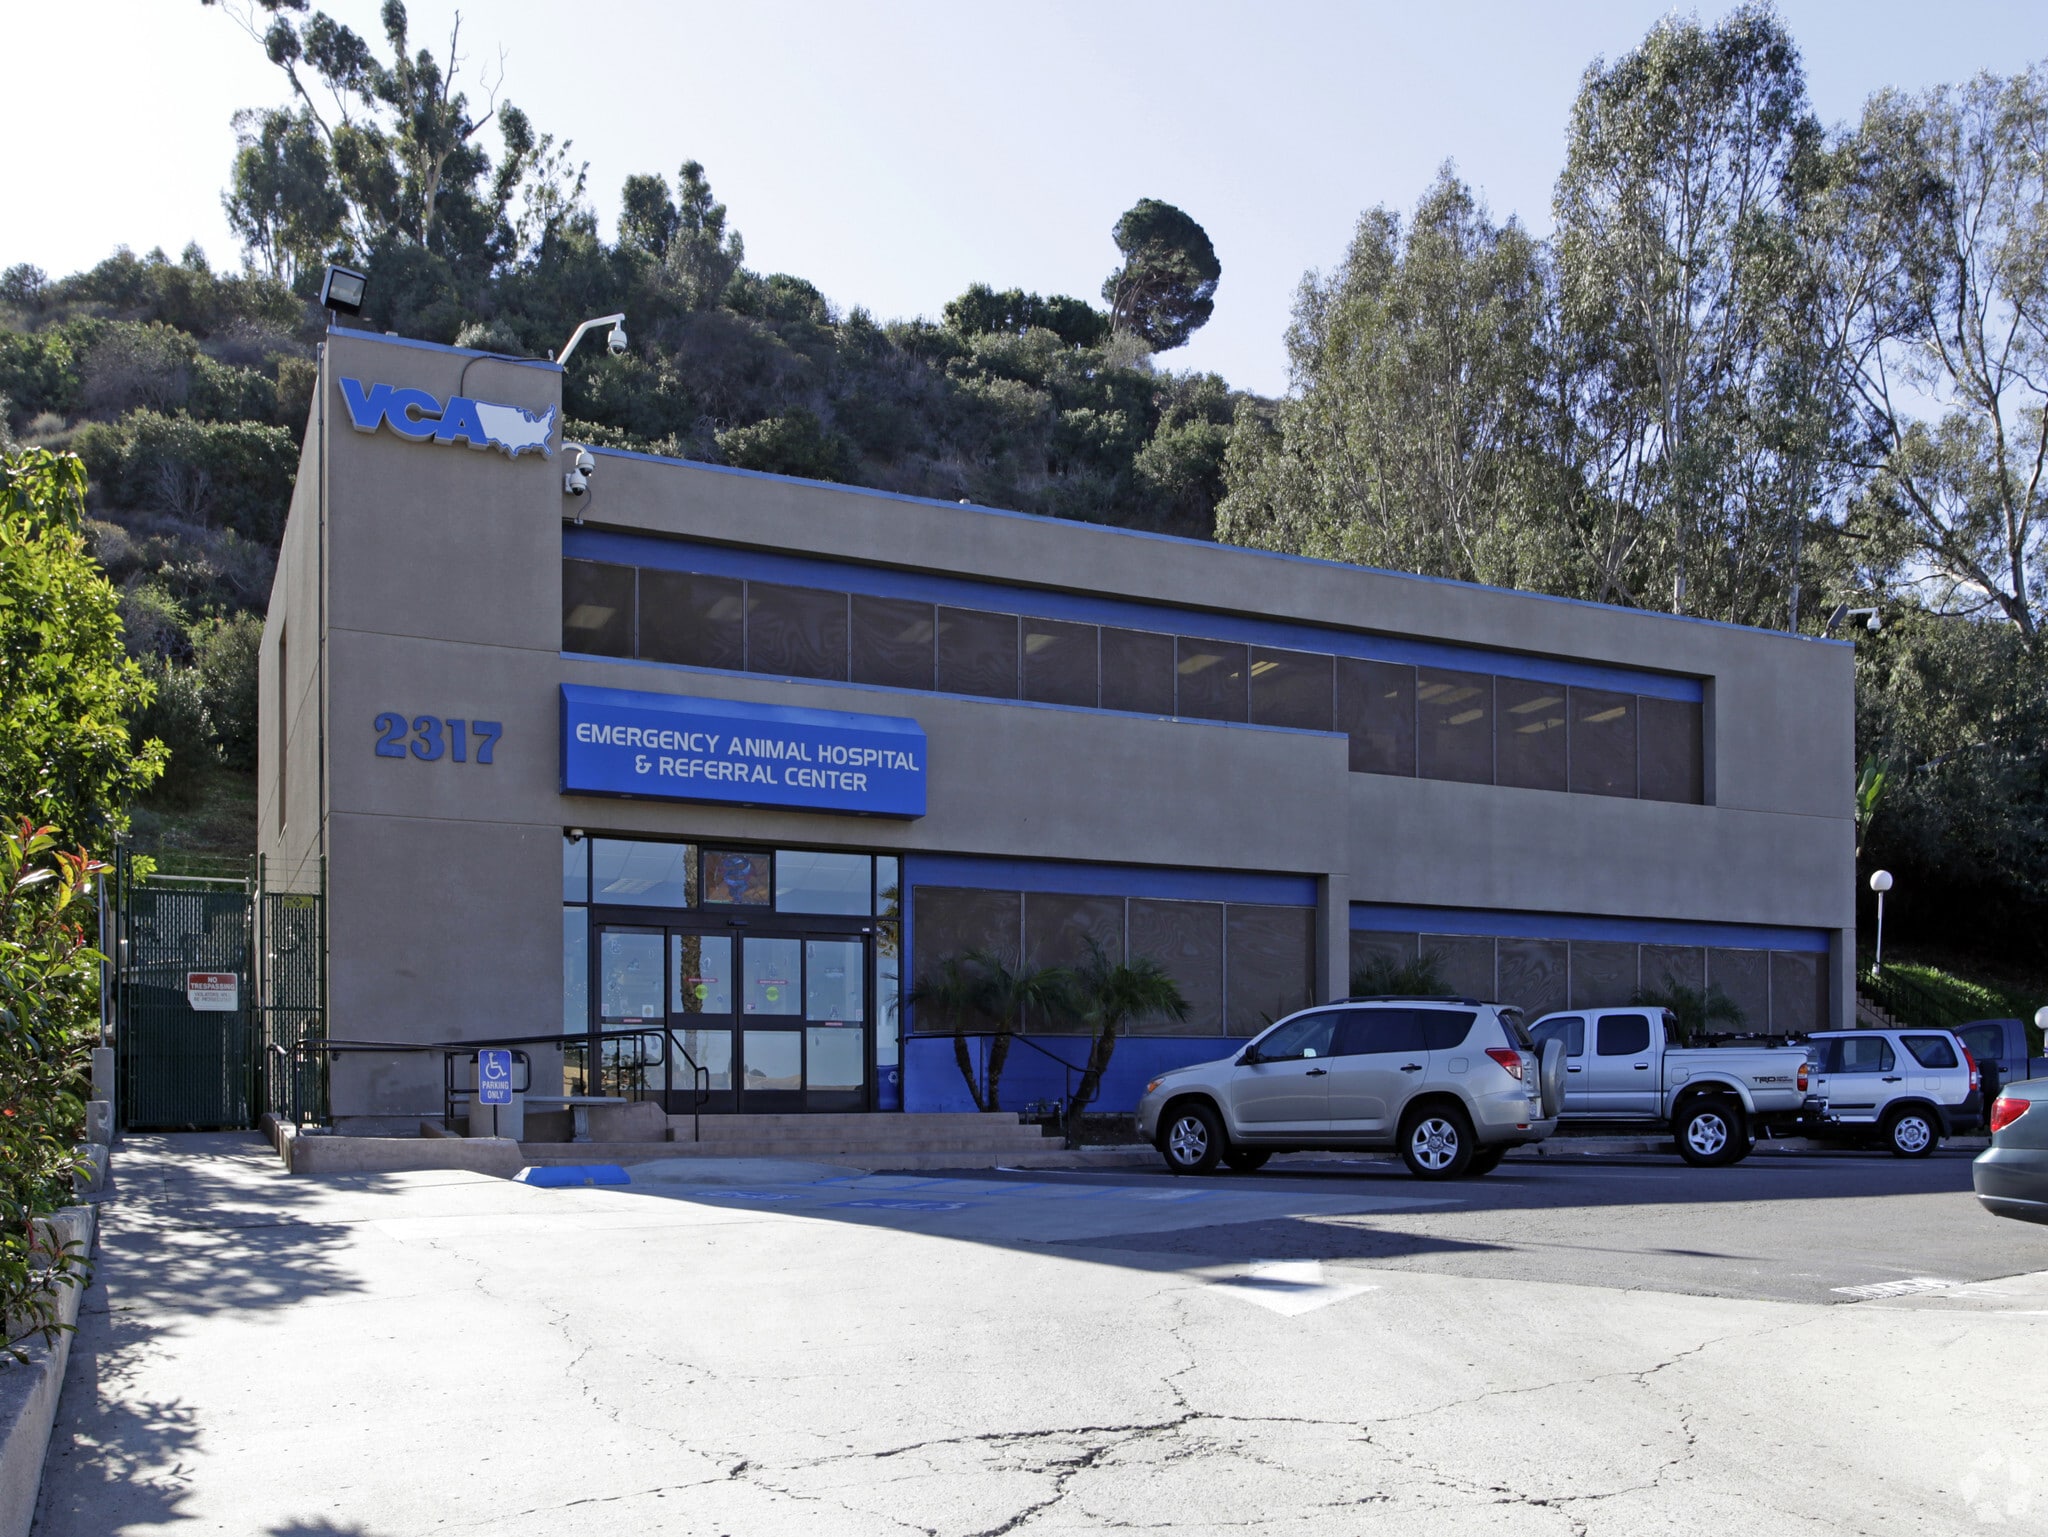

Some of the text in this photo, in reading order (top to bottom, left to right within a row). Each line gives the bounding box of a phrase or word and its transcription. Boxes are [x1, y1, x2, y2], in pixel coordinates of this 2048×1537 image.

[338, 376, 489, 448] VCA
[374, 712, 503, 765] 2317
[575, 722, 920, 772] EMERGENCY ANIMAL HOSPITAL
[635, 754, 868, 792] & REFERRAL CENTER
[482, 1081, 509, 1089] PARKING
[487, 1090, 504, 1099] ONLY
